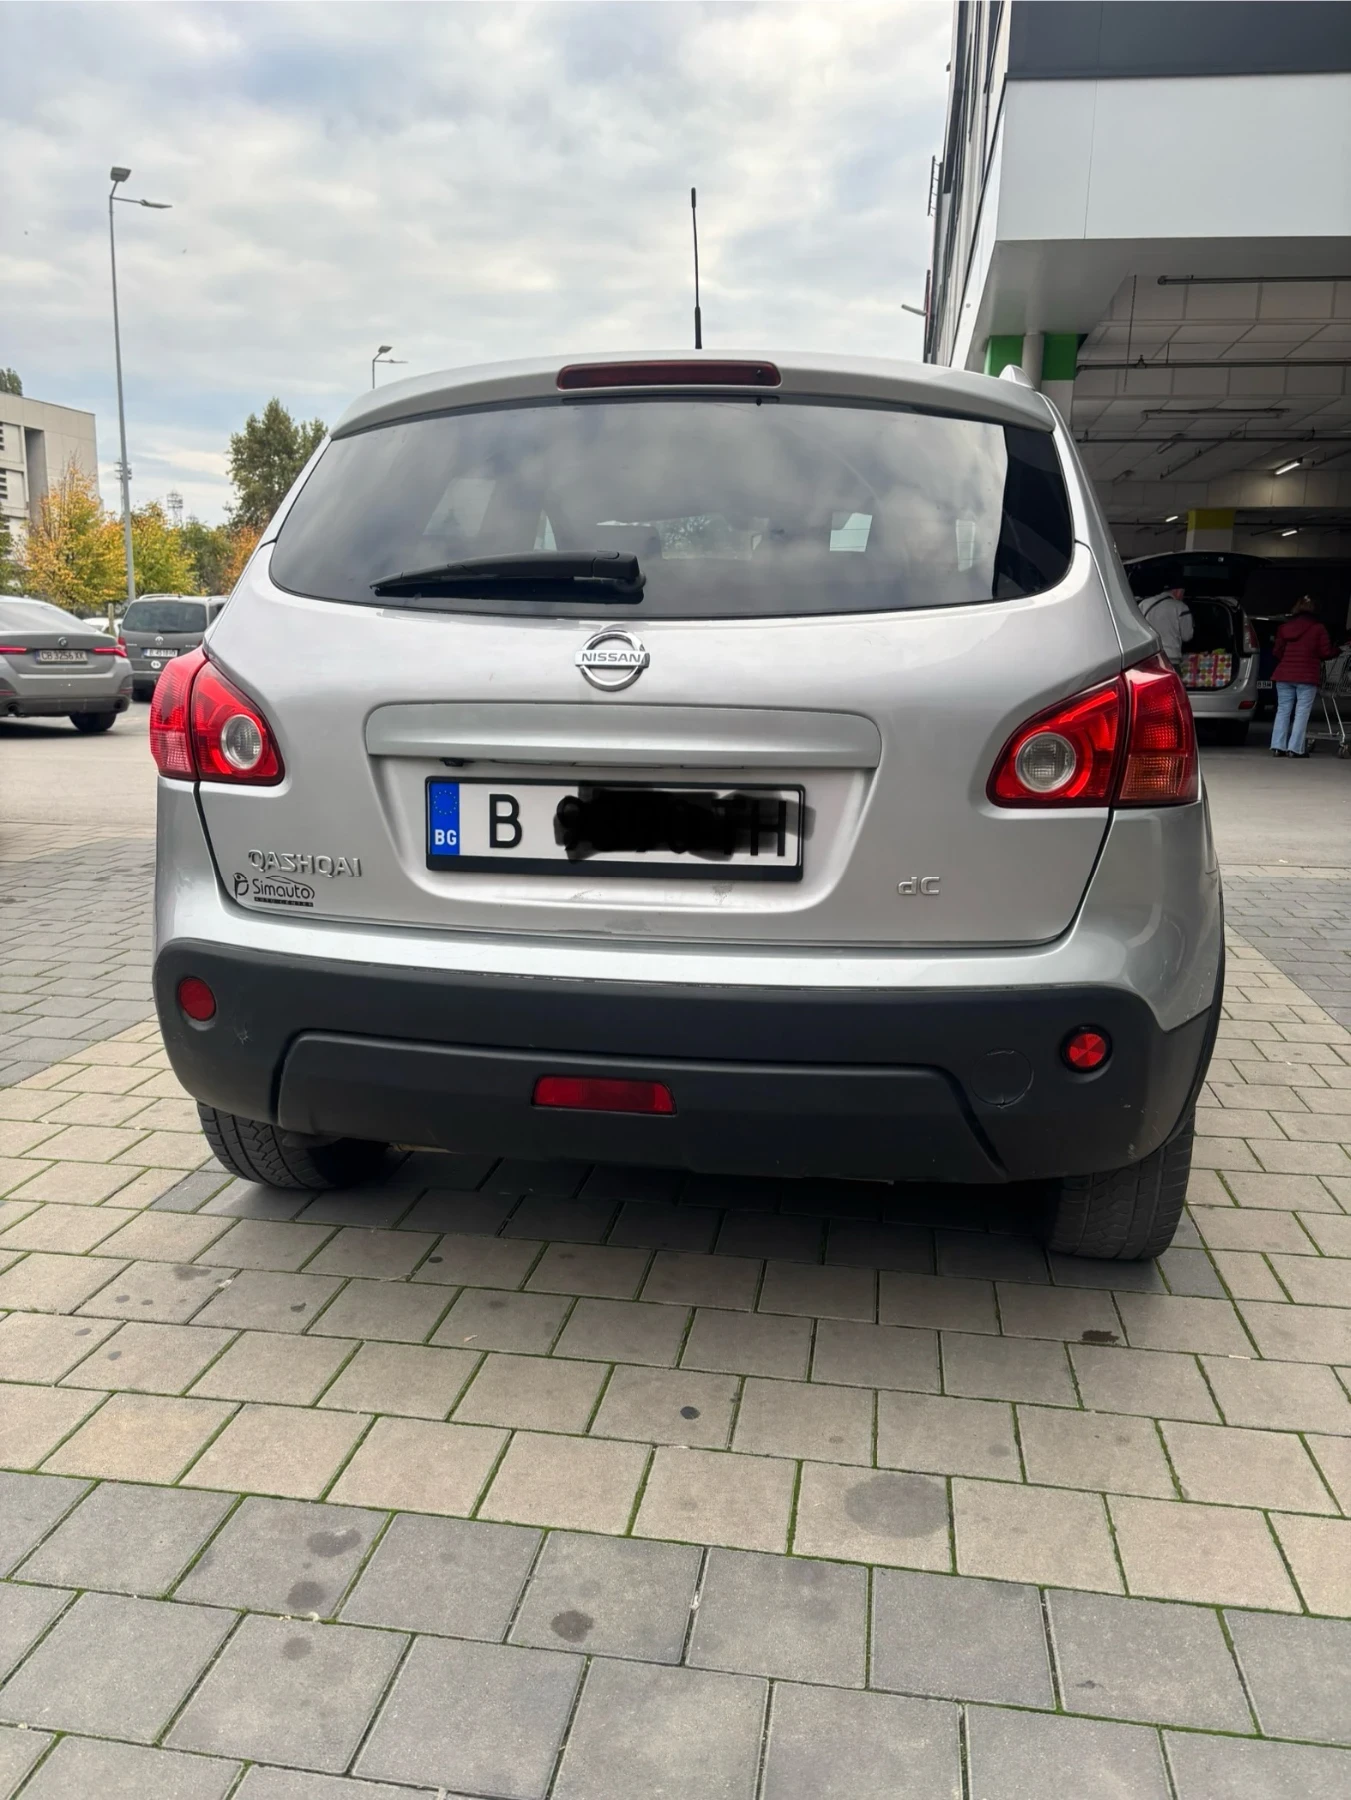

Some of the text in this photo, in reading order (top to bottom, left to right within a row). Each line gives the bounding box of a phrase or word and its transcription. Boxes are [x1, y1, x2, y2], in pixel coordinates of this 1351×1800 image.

[581, 652, 641, 663] NISSAN
[489, 793, 523, 849] B
[434, 829, 457, 846] BG
[248, 849, 362, 878] QASHQAI
[252, 878, 311, 900] Simauto
[898, 876, 940, 896] dC
